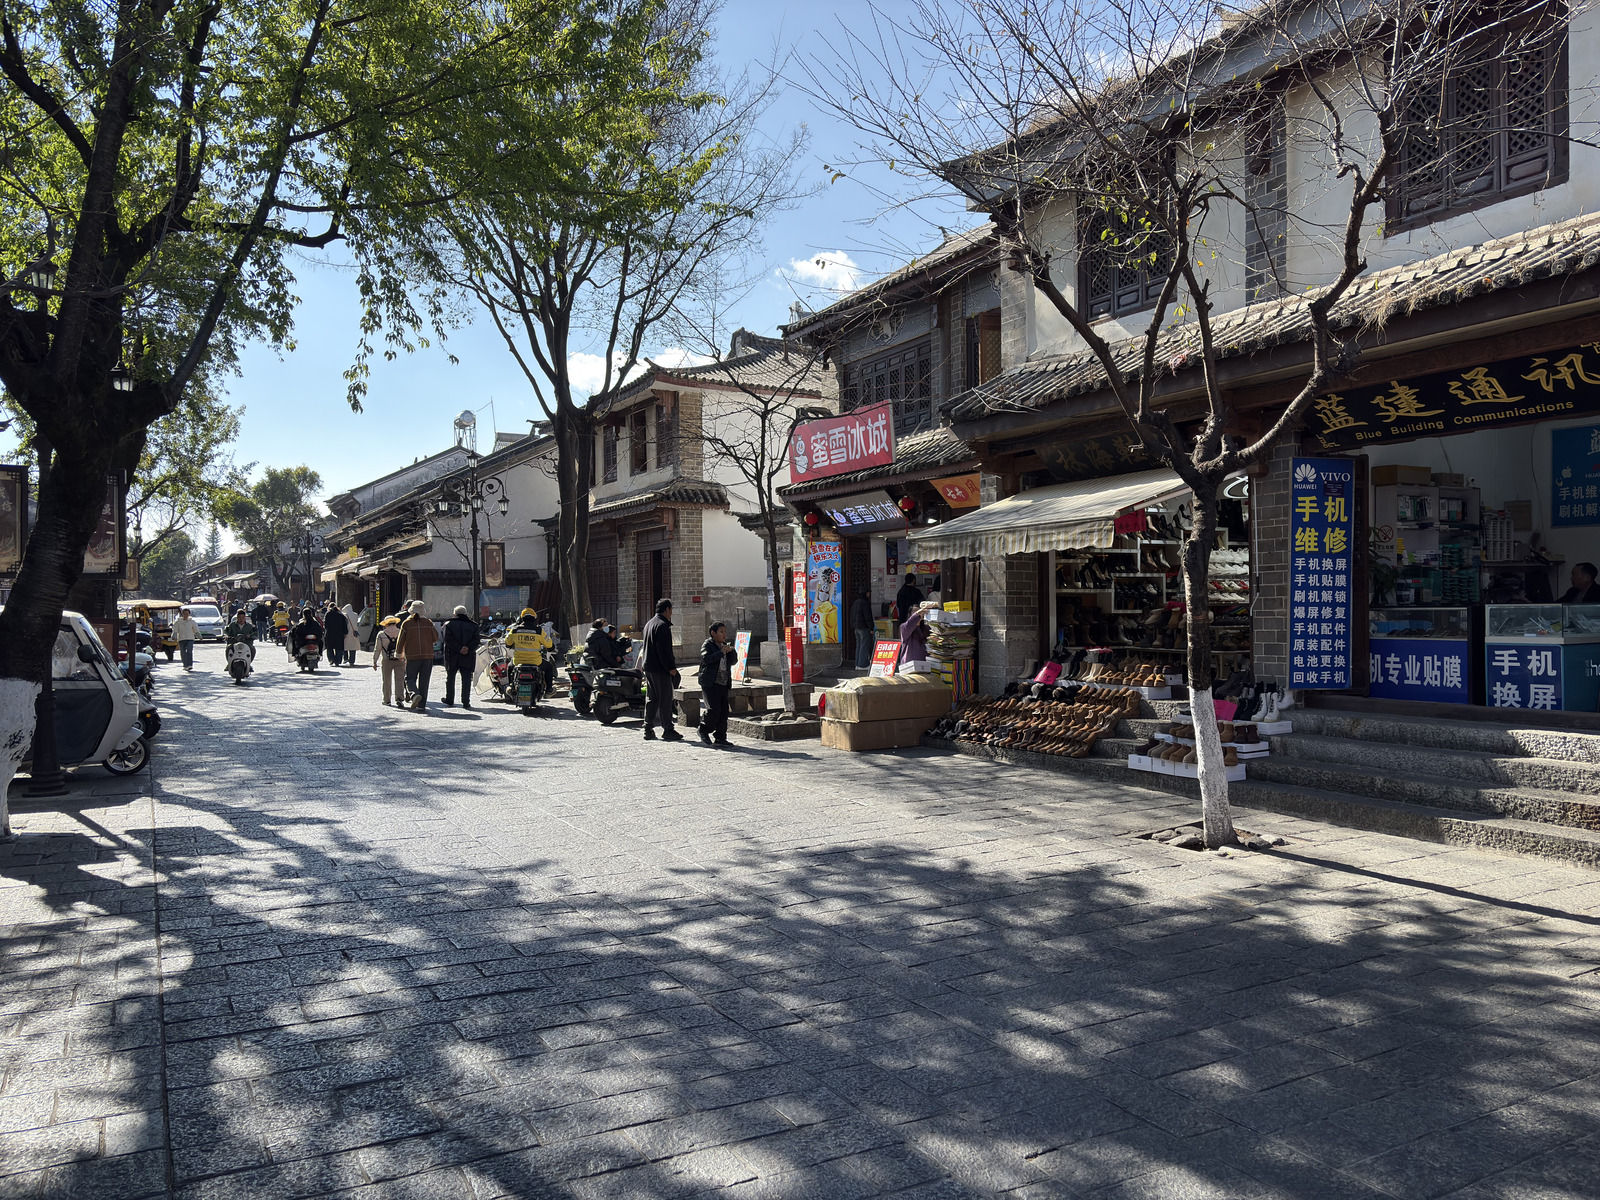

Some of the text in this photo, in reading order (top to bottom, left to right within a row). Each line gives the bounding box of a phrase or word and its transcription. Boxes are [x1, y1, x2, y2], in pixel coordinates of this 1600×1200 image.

[1355, 400, 1574, 441] Blue Building Communications
[810, 413, 889, 469] 蜜雪冰城
[1320, 472, 1351, 482] VIVO
[1558, 485, 1600, 501] 手机维
[843, 500, 903, 525] 蜜雪冰城
[1295, 496, 1348, 522] 手机
[1558, 502, 1600, 518] 刷机解
[1295, 527, 1347, 554] 维修
[1294, 558, 1347, 571] 手机换屏
[1294, 574, 1347, 587] 手机贴膜
[1293, 590, 1346, 603] 刷机解锁
[1293, 606, 1346, 619] 爆屏修复
[1293, 622, 1346, 635] 手机配件
[1293, 639, 1346, 651] 原装配件
[1293, 655, 1346, 668] 电池更换
[1491, 649, 1557, 677] 手机
[1293, 671, 1346, 684] 回收手机
[1369, 652, 1462, 689] 机专业贴膜
[1492, 682, 1558, 711] 换屏
